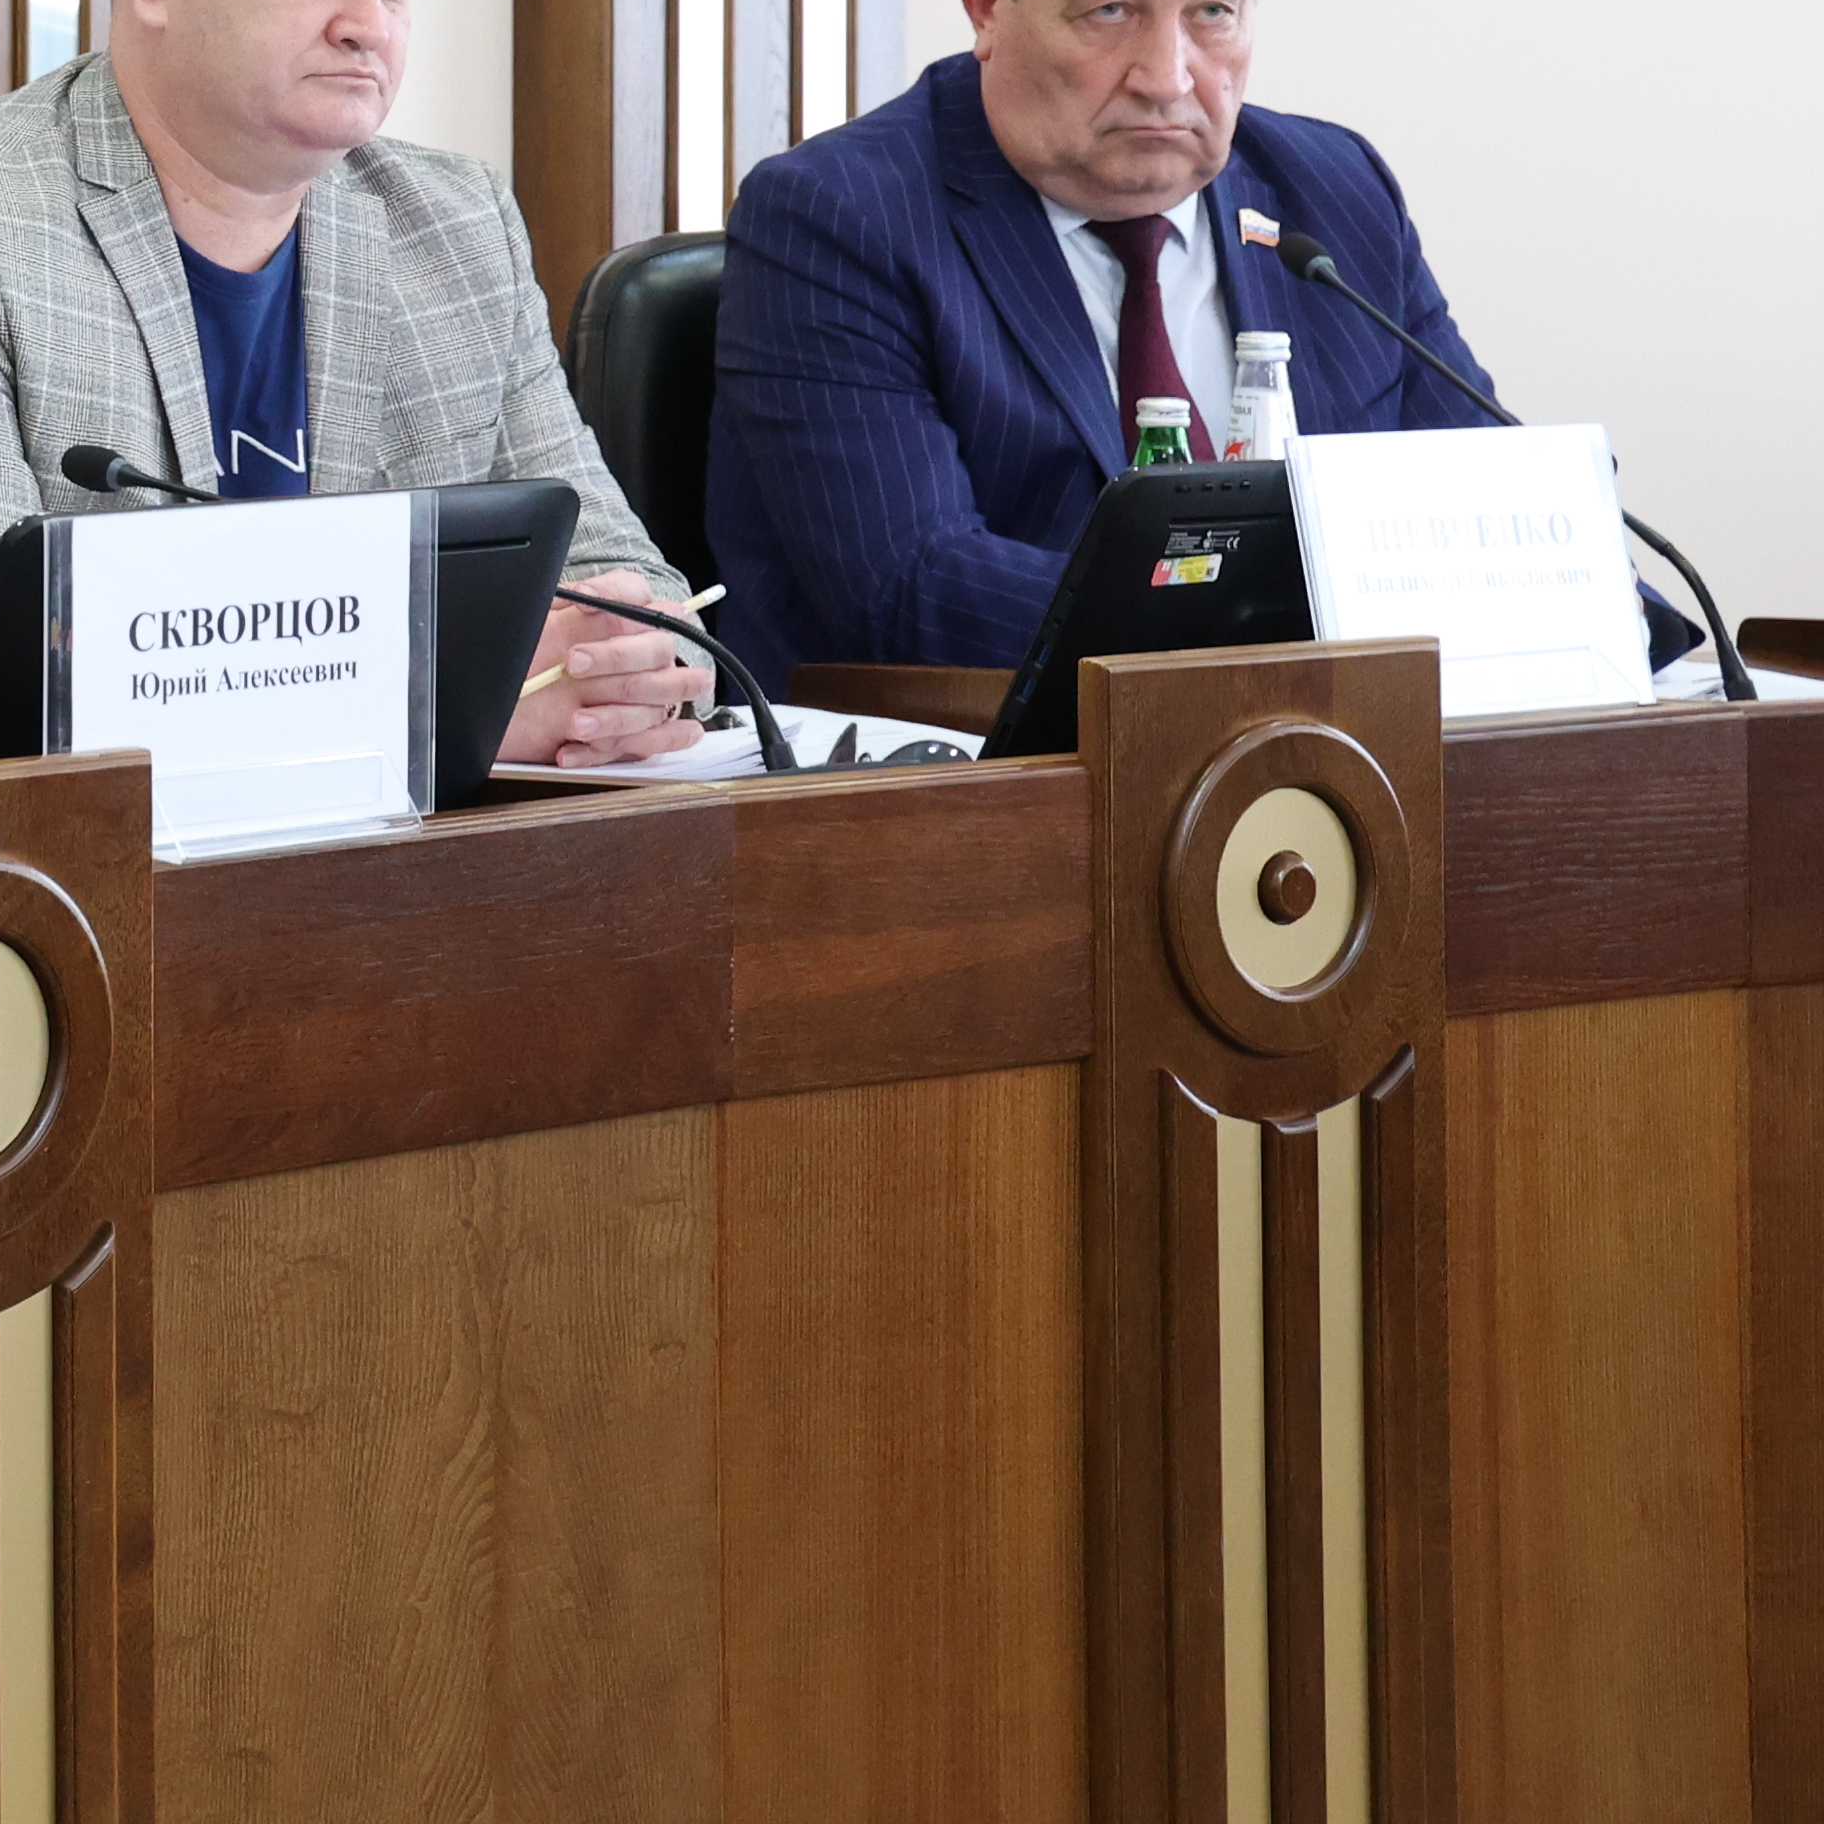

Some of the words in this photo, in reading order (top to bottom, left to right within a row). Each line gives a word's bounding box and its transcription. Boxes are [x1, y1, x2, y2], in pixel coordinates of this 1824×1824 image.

[214, 428, 306, 477] N
[128, 594, 361, 652] СКВОРЦОВ
[129, 667, 207, 706] Юрий
[215, 660, 358, 693] Алексеевич
